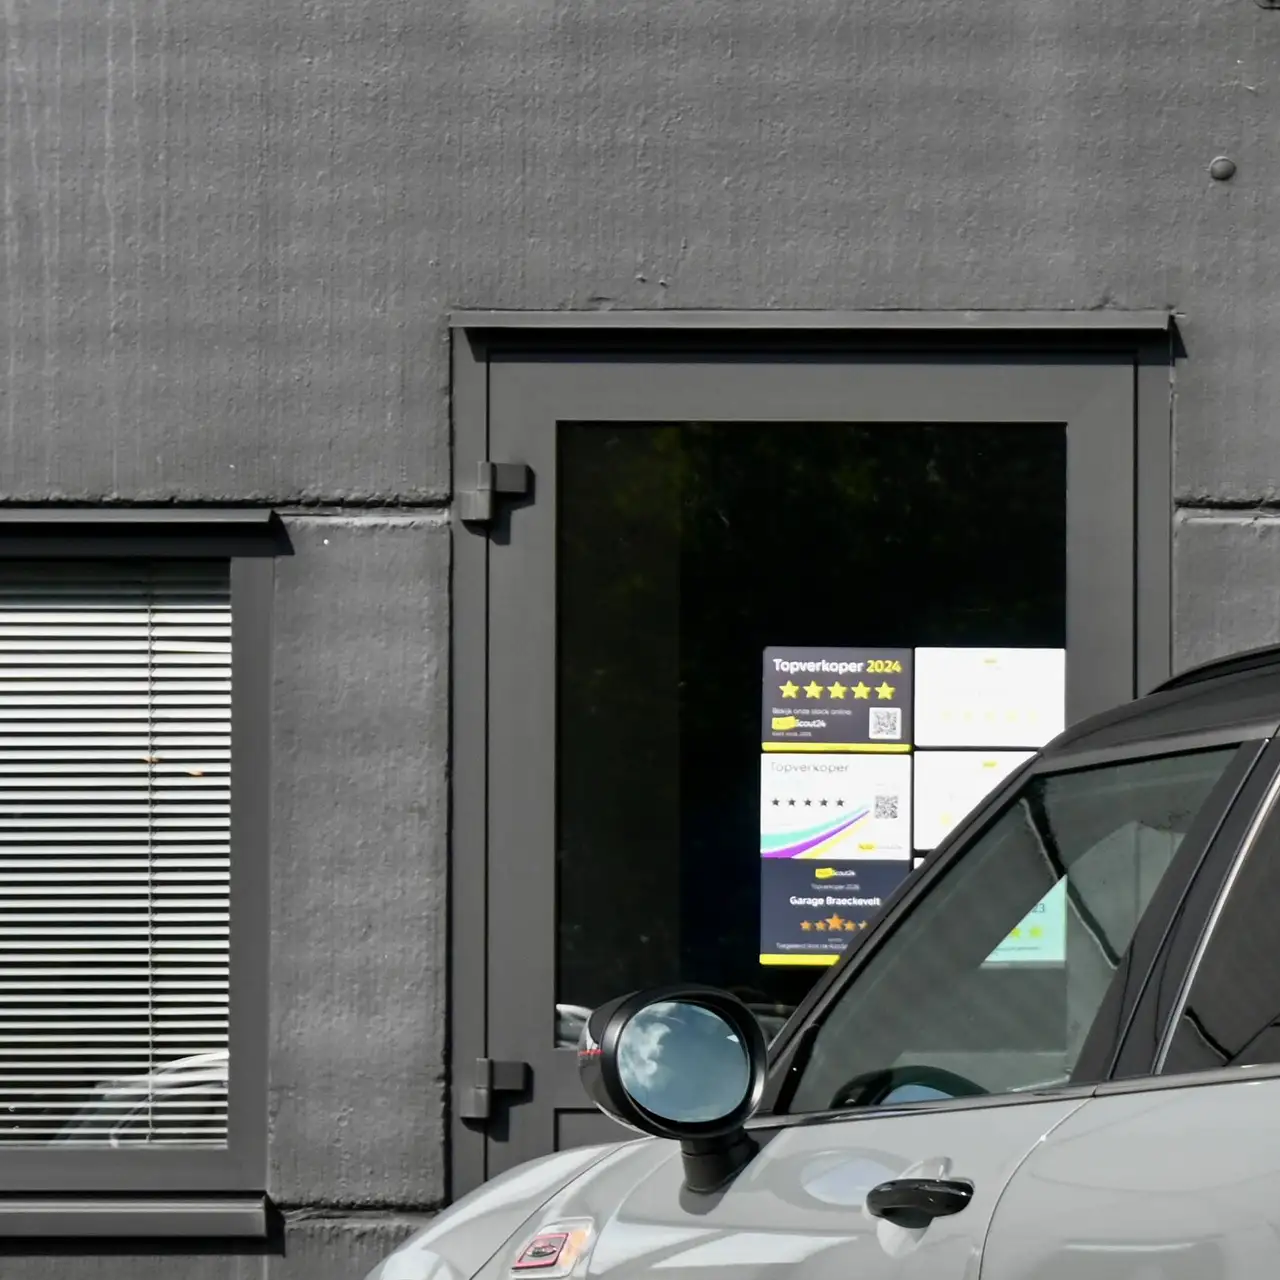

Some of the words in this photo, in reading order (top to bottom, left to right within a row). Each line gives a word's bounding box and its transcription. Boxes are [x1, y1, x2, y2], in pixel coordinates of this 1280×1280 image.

[773, 659, 864, 674] Topverkoper
[866, 660, 902, 673] 2024
[771, 762, 849, 773] Topverkoper
[789, 896, 824, 907] Garage
[825, 896, 881, 906] Braeckevelt
